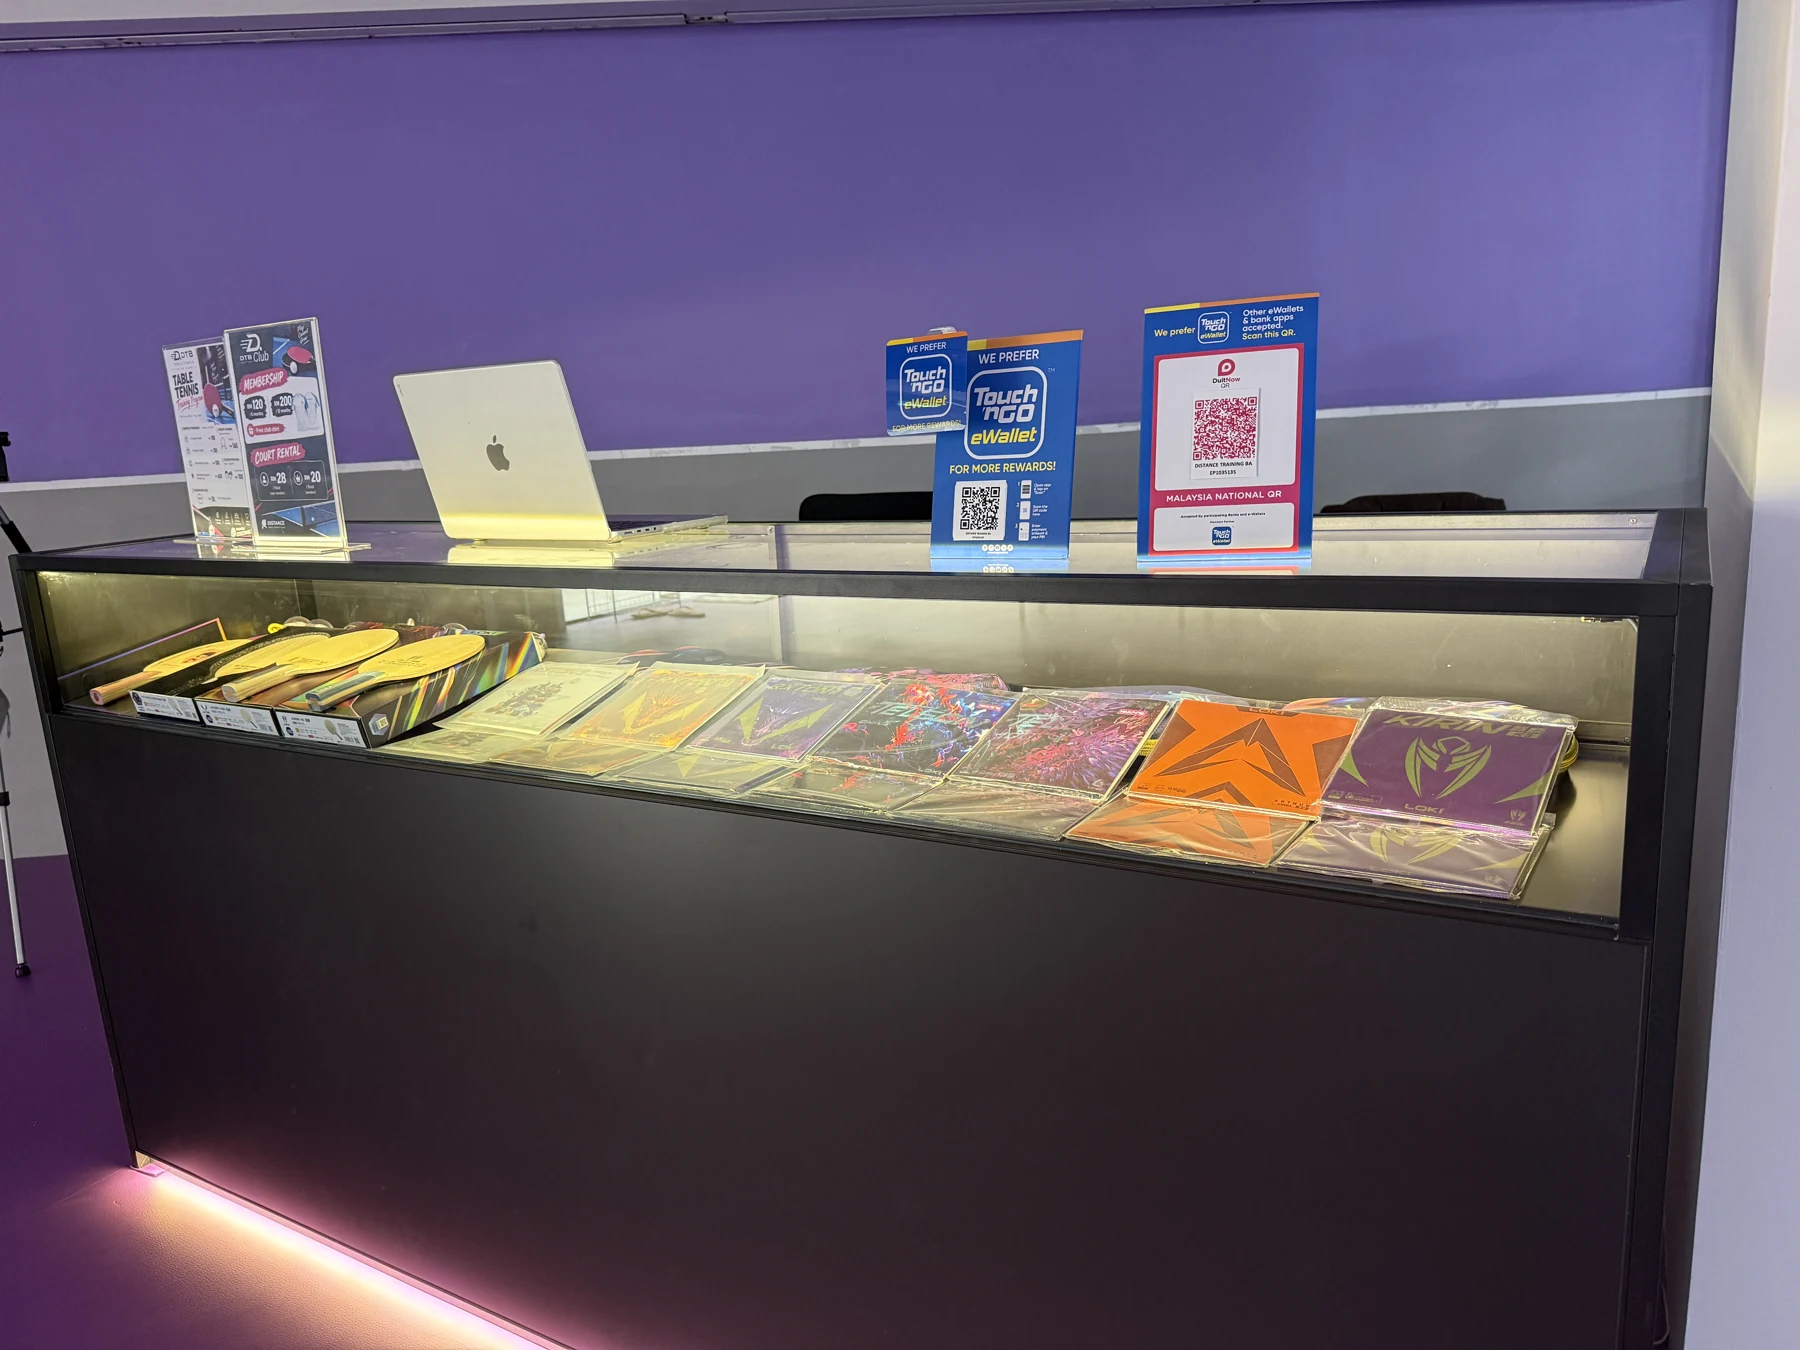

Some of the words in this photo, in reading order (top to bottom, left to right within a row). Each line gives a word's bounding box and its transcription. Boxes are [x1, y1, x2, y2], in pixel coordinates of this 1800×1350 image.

[1242, 309, 1266, 317] Other
[1268, 305, 1304, 315] eWallets
[1200, 317, 1227, 326] Touch
[1250, 315, 1271, 324] bank
[1273, 314, 1294, 323] apps
[1154, 329, 1168, 337] We
[1170, 326, 1196, 337] prefer
[1242, 321, 1284, 332] accepted.
[1200, 331, 1227, 339] eWallet
[1242, 332, 1262, 340] Scan
[1264, 330, 1279, 338] this
[1281, 329, 1296, 337] QR.
[905, 346, 918, 354] WE
[920, 341, 947, 352] PREFER
[253, 351, 269, 362] Club
[979, 353, 996, 364] WE
[998, 349, 1040, 363] PREFER
[172, 371, 194, 387] TABLE
[243, 370, 284, 391] MEMBERSHIP
[904, 366, 947, 383] Touch
[174, 382, 199, 399] TENNIS
[973, 384, 1038, 407] Touch
[252, 398, 264, 410] 120
[280, 395, 292, 407] 200
[904, 395, 947, 410] eWallet
[907, 422, 926, 431] MORE
[970, 426, 1037, 445] eWallet
[254, 448, 276, 465] COURT
[276, 445, 301, 460] RENTAL
[949, 465, 970, 475] FOR
[971, 463, 1001, 474] MORE
[1003, 461, 1056, 473] REWARDS!
[276, 472, 286, 484] 28
[310, 471, 321, 483] 20
[1166, 493, 1213, 503] MALAYSIA
[1215, 491, 1265, 501] NATIONAL
[1267, 490, 1282, 498] QR
[1382, 714, 1511, 735] KIRIN
[1404, 803, 1445, 814] LOKI
